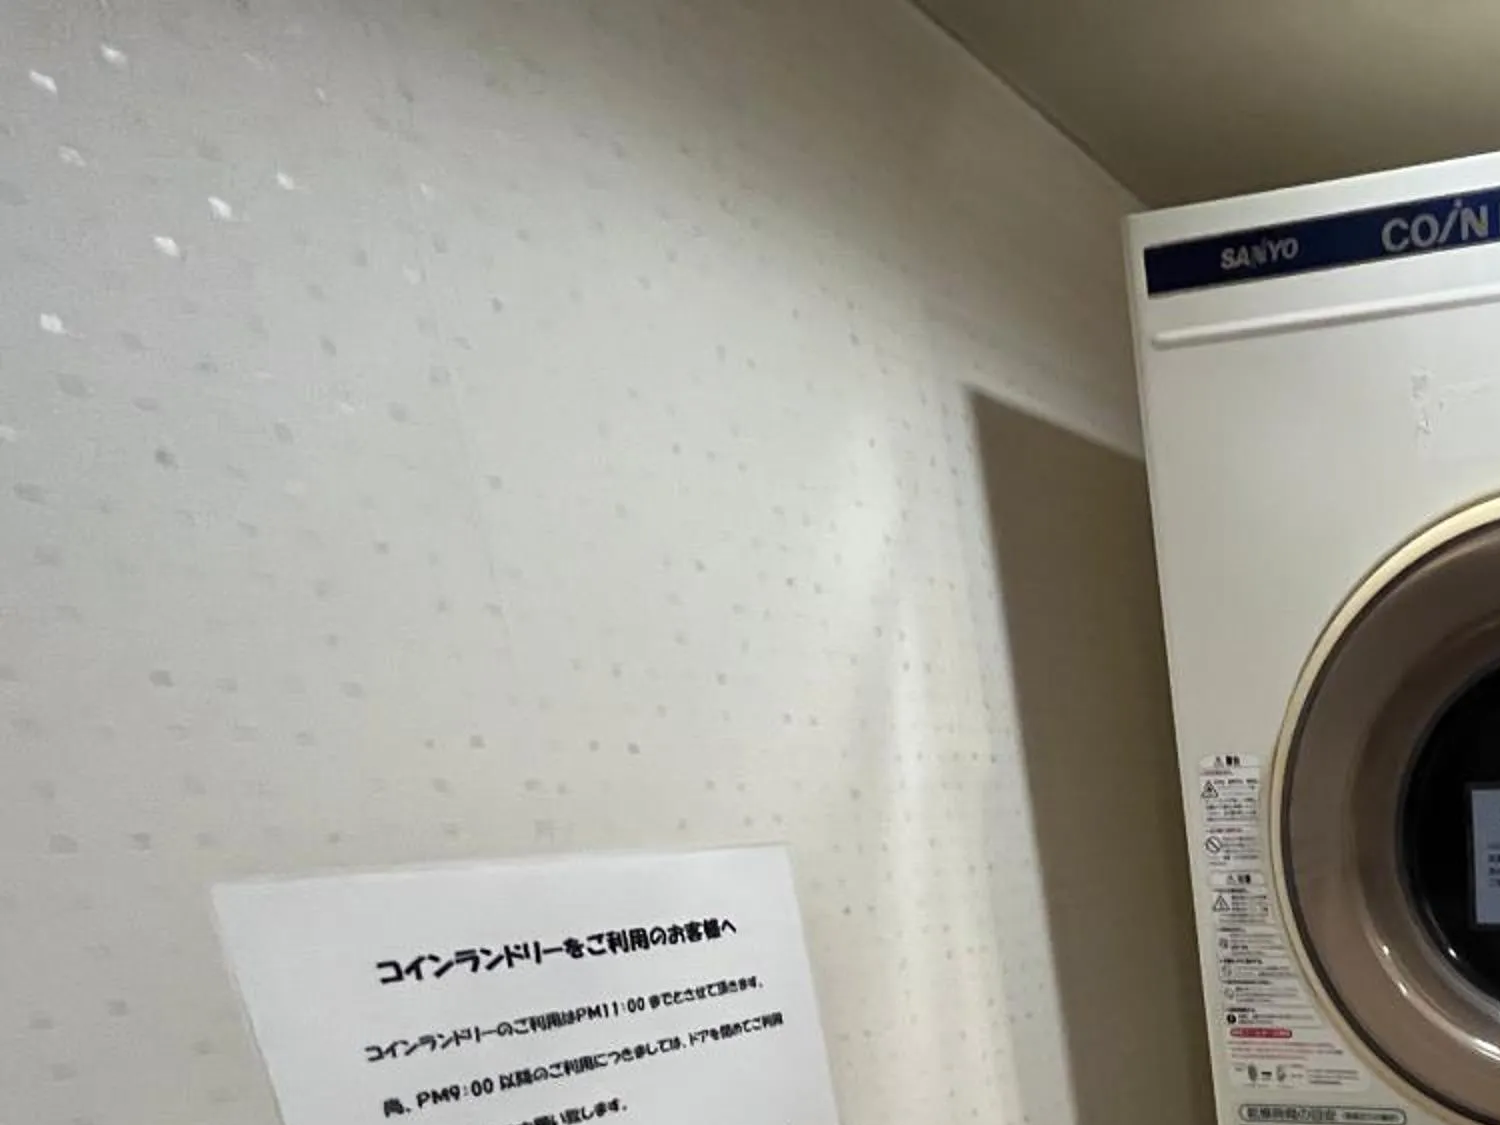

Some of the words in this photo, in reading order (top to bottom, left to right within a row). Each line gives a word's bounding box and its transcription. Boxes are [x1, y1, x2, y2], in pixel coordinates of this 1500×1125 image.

[1221, 237, 1299, 270] SANYO
[376, 918, 737, 984] コインランドリーをご利用のお客様へ
